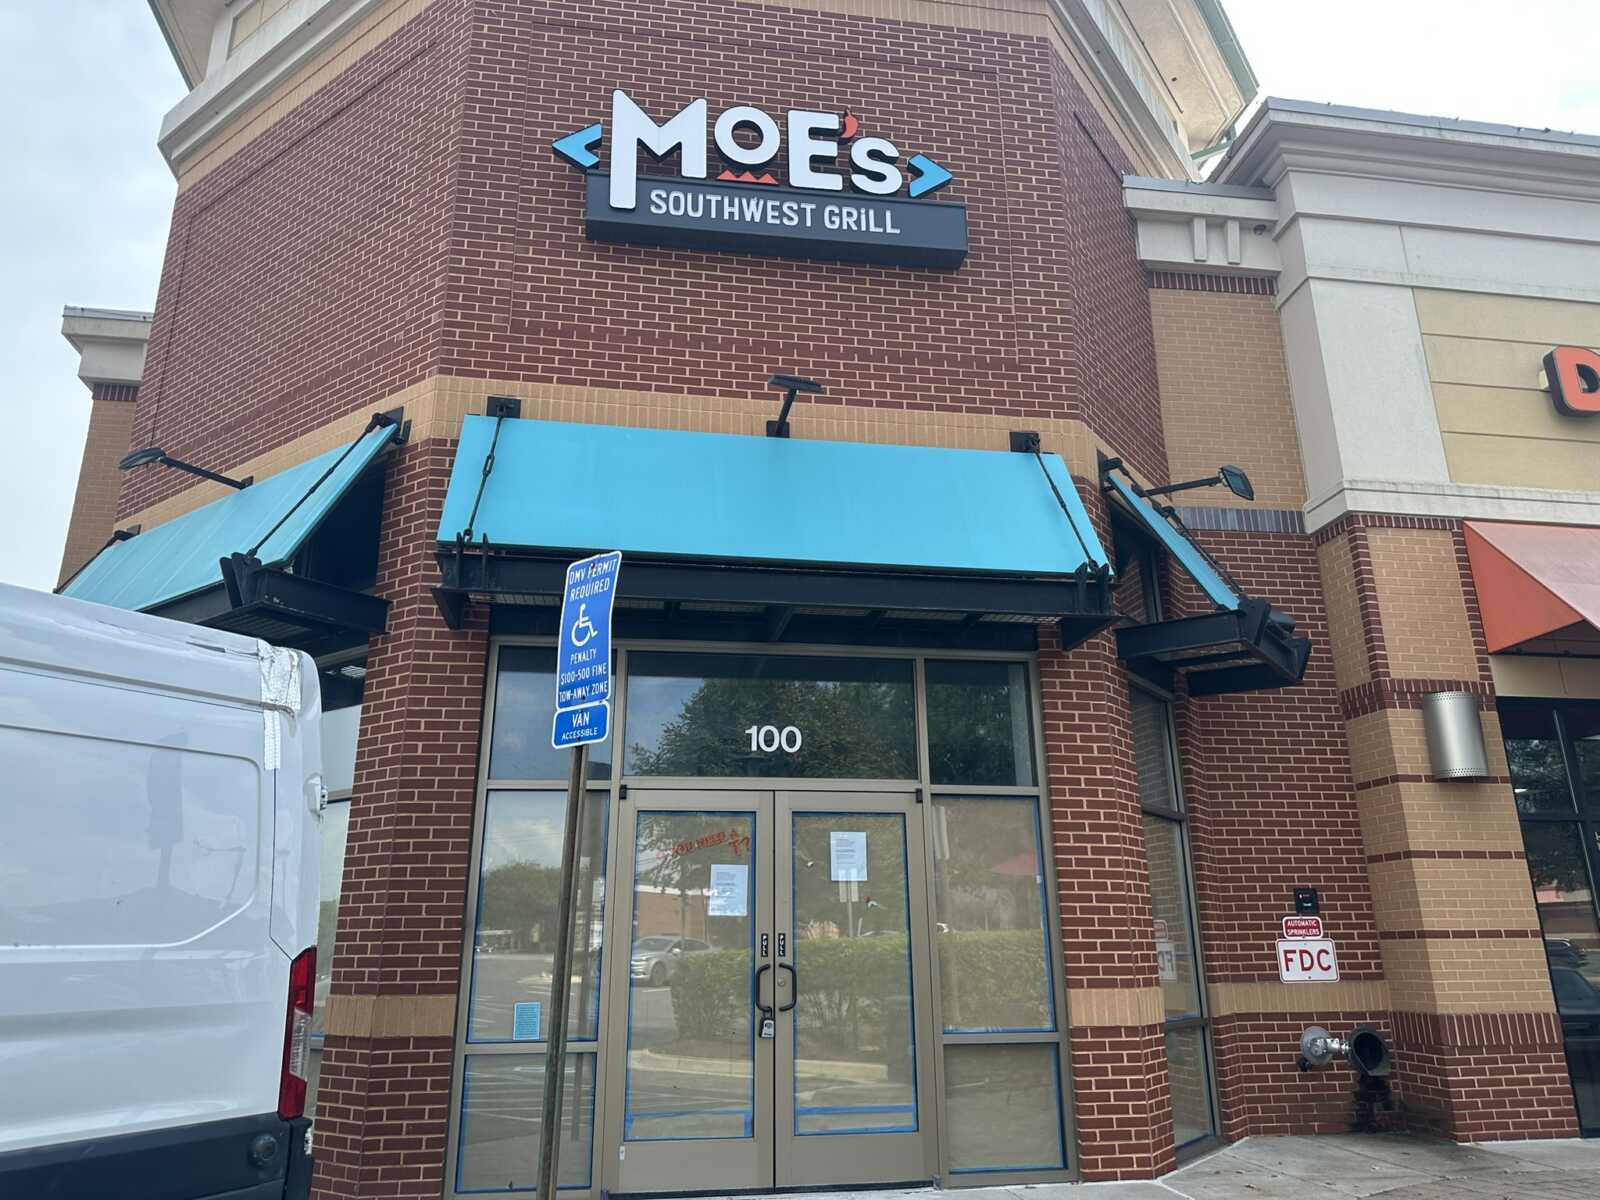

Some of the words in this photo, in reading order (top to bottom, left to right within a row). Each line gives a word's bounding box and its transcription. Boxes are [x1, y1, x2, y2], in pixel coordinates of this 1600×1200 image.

[649, 188, 817, 228] SOUTHWEST
[569, 567, 587, 585] DMV
[570, 577, 610, 601] REQUIRED
[570, 647, 597, 665] PENALTY
[591, 662, 607, 677] FINE
[559, 685, 590, 703] TOW-AWAY
[591, 680, 608, 696] ZONE
[572, 711, 590, 728] VAN
[561, 727, 598, 741] ACCESSIBLE
[744, 725, 802, 753] 100
[1287, 928, 1320, 936] SPRINKLERS
[1283, 949, 1331, 972] FDC
